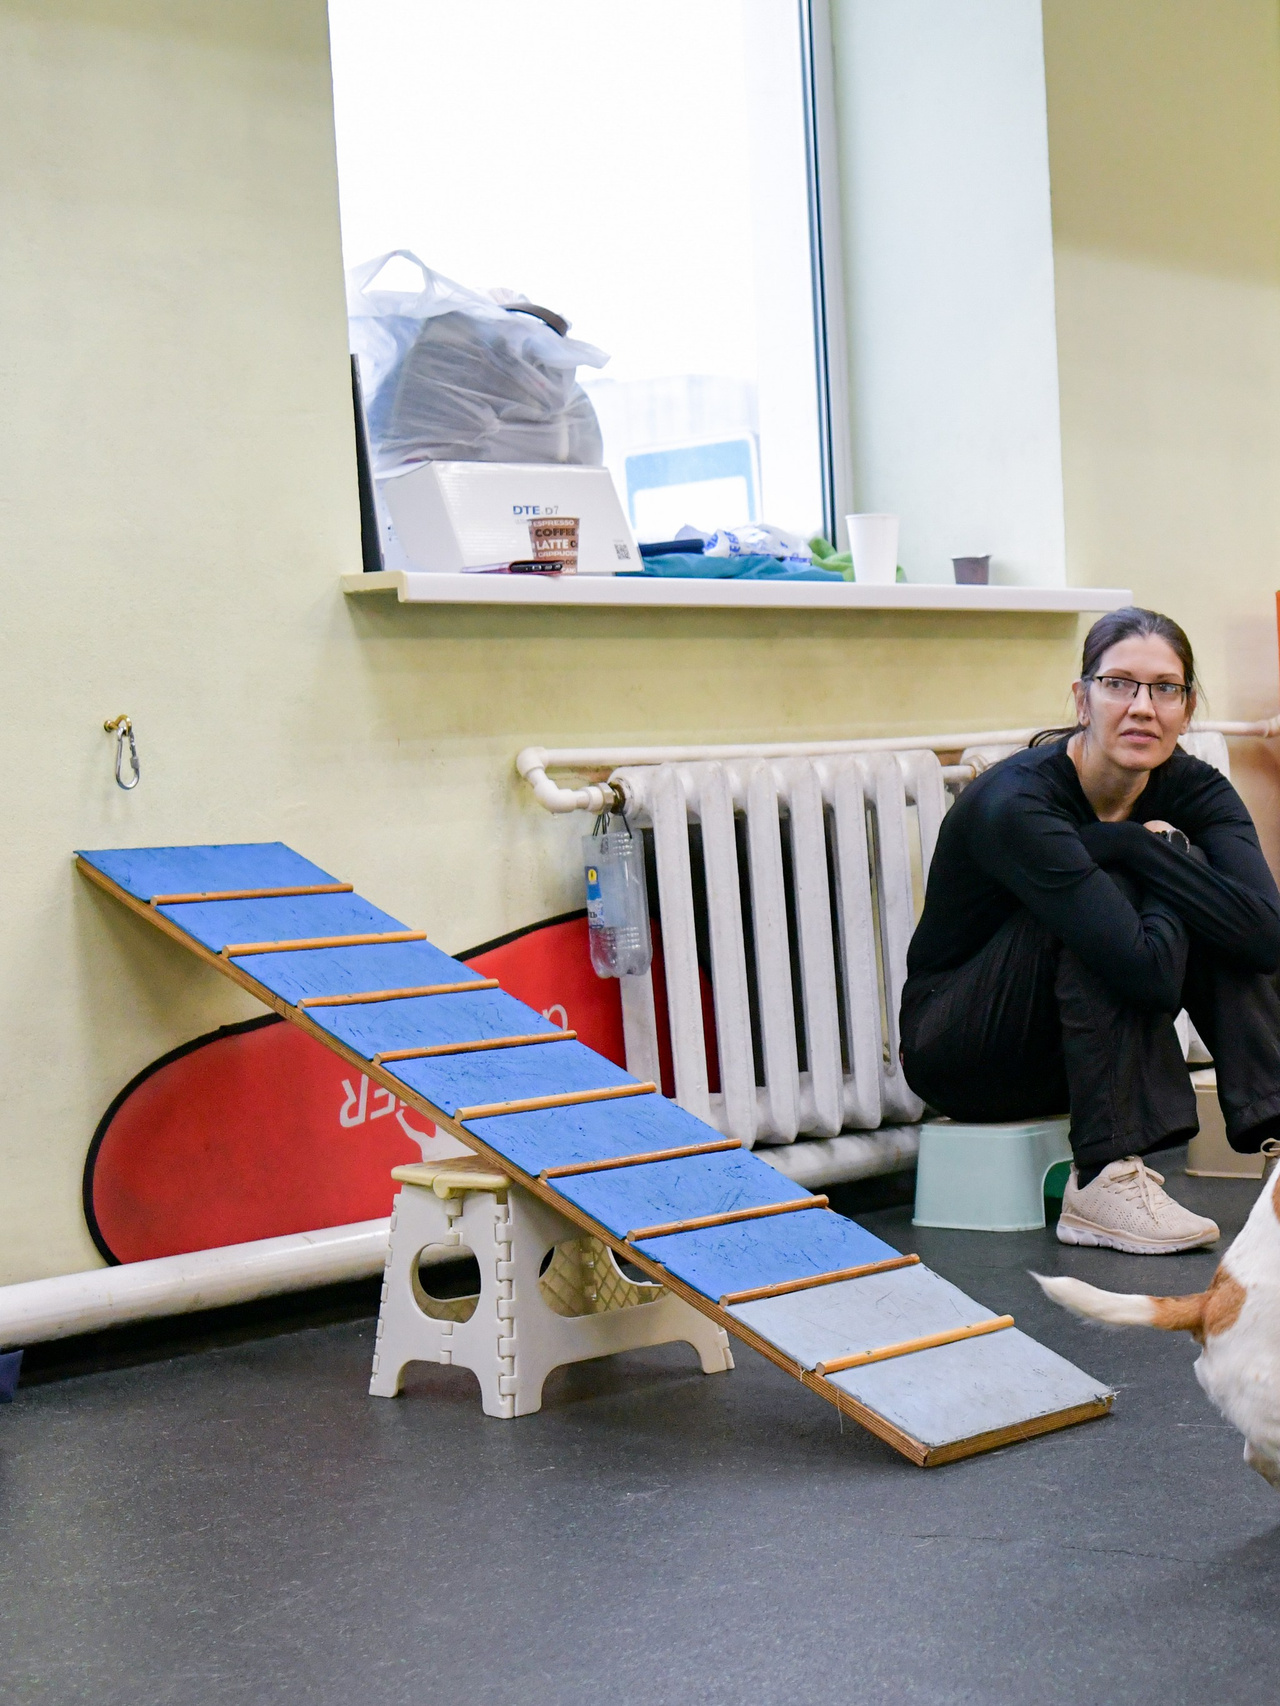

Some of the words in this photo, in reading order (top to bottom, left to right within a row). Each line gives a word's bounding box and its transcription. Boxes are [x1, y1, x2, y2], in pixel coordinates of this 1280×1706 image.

[513, 505, 540, 515] DTE
[535, 528, 576, 537] COFFEE
[536, 538, 569, 551] LATTE
